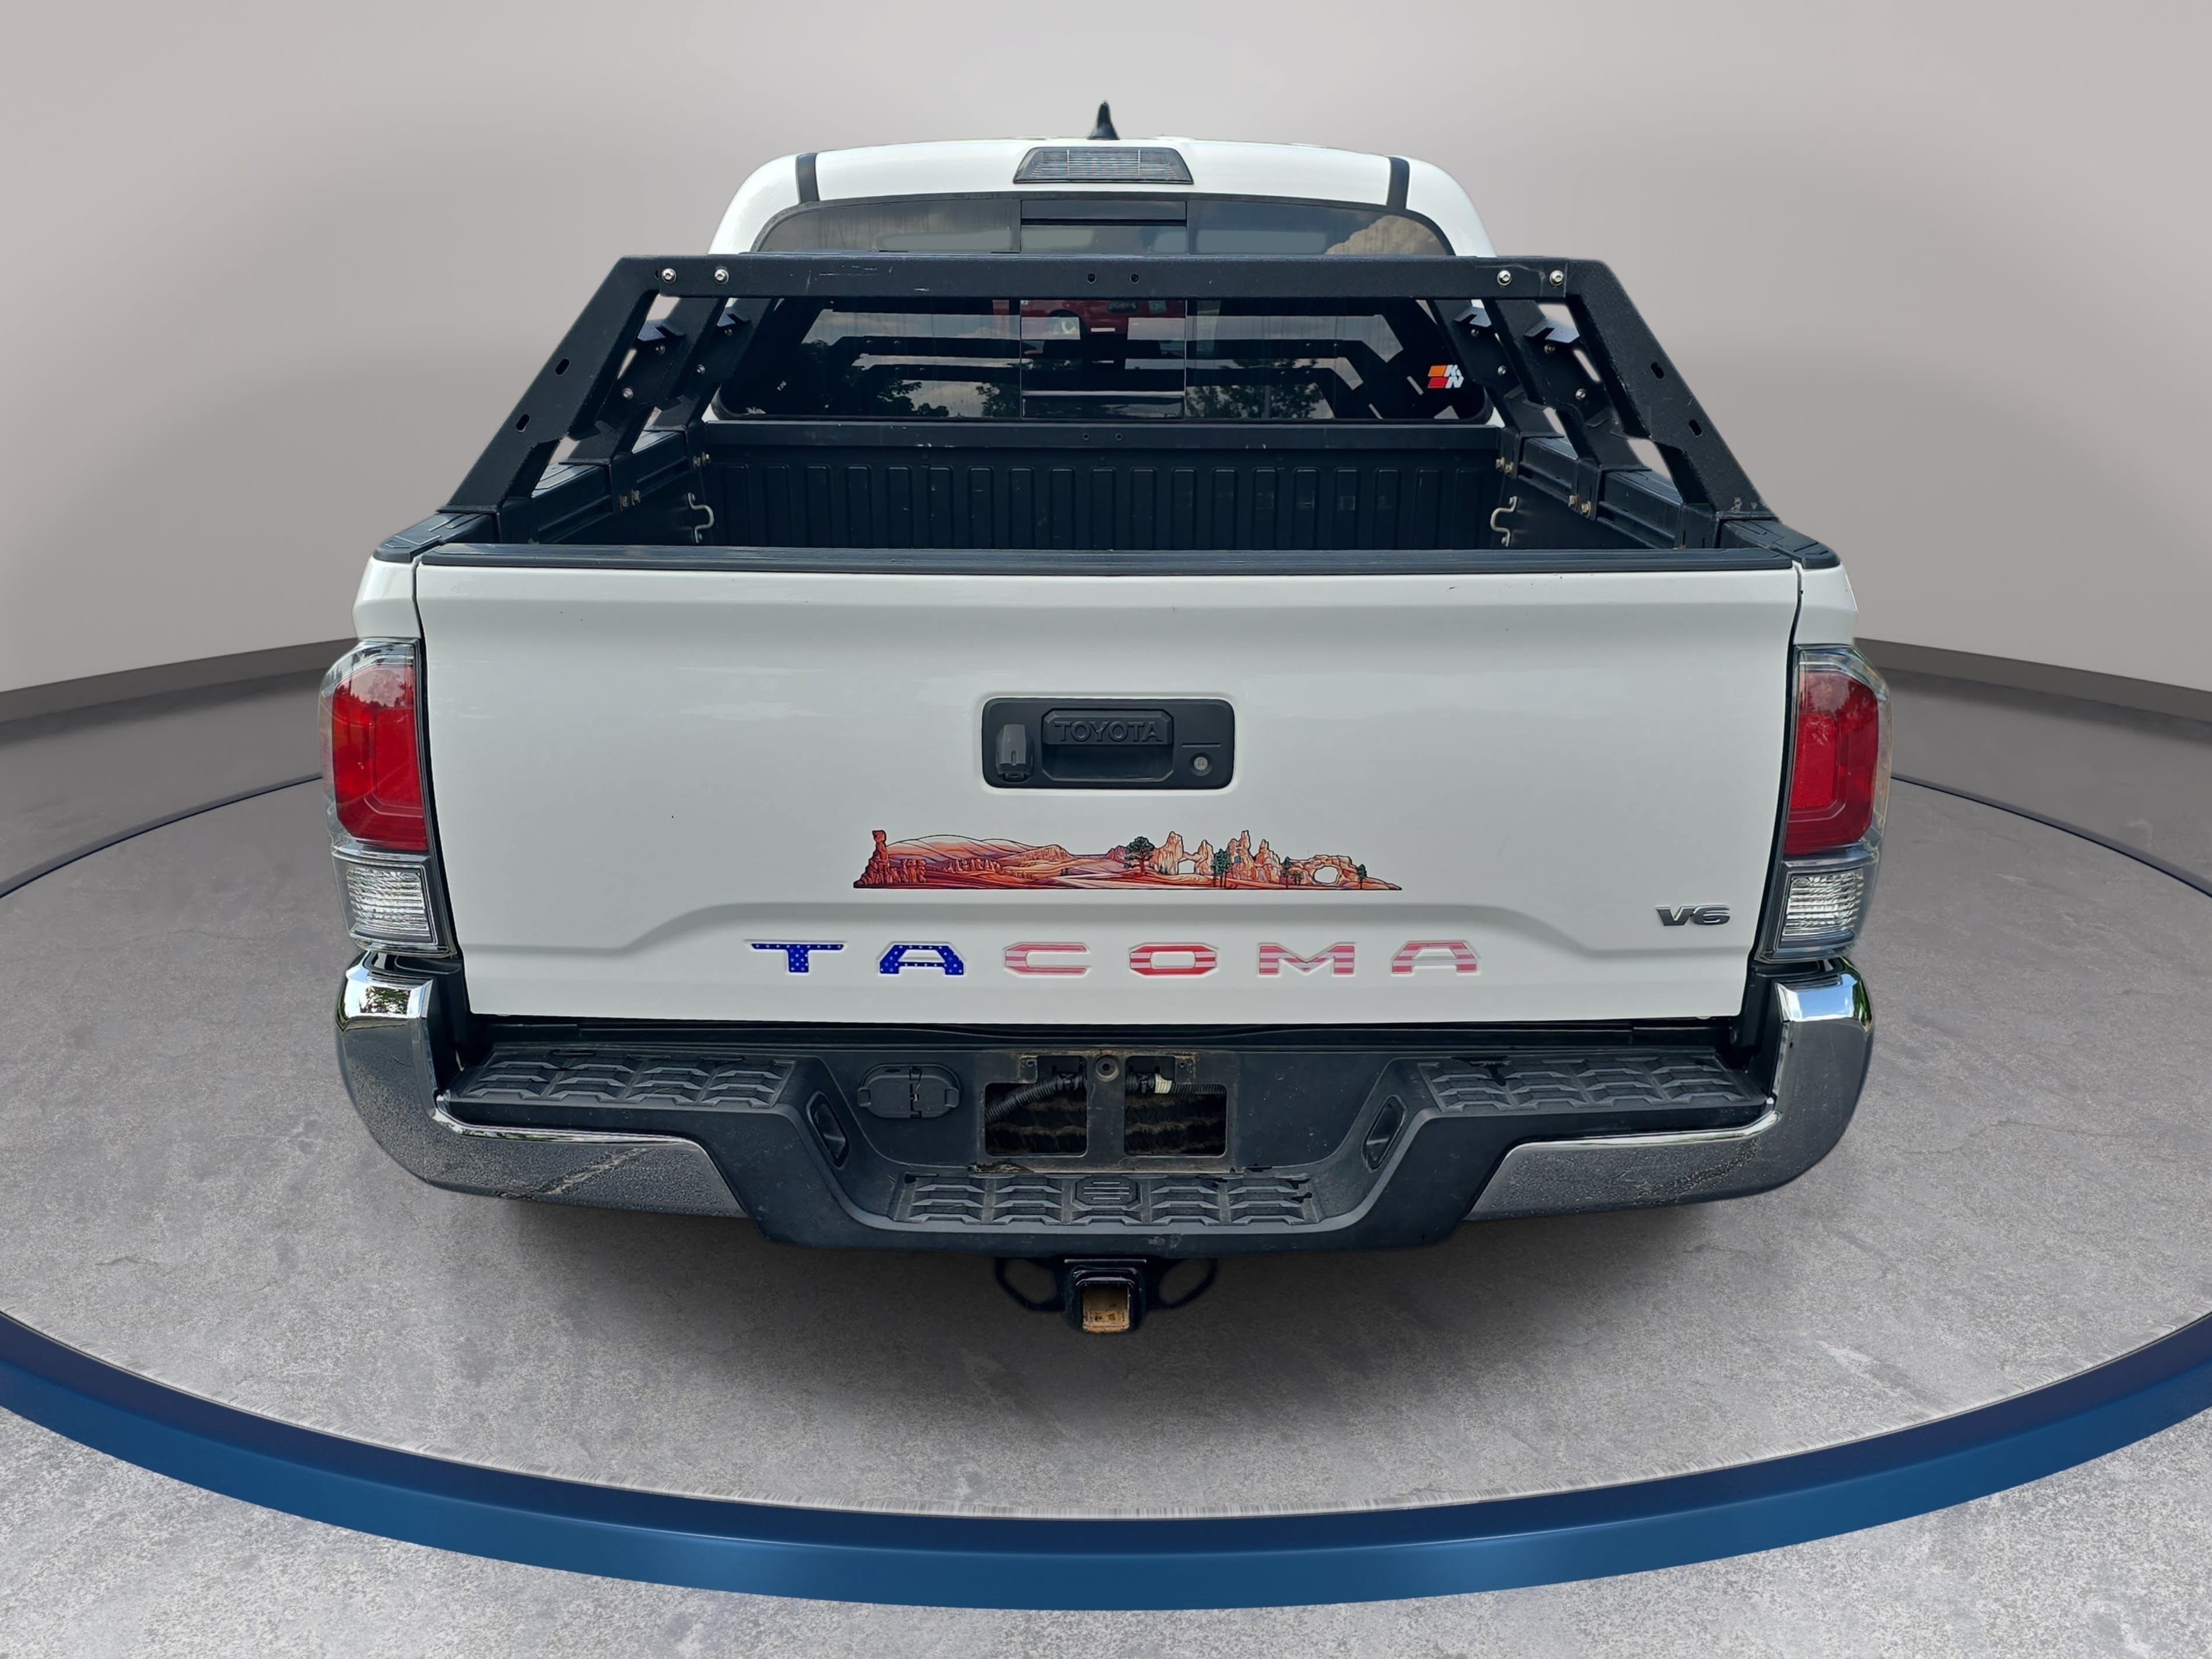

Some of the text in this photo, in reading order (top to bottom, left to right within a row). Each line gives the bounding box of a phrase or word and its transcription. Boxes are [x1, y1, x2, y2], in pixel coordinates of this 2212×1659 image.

[1054, 721, 1163, 742] TOYOTA
[1655, 904, 1731, 927] V6
[749, 941, 1479, 975] TACOMA
